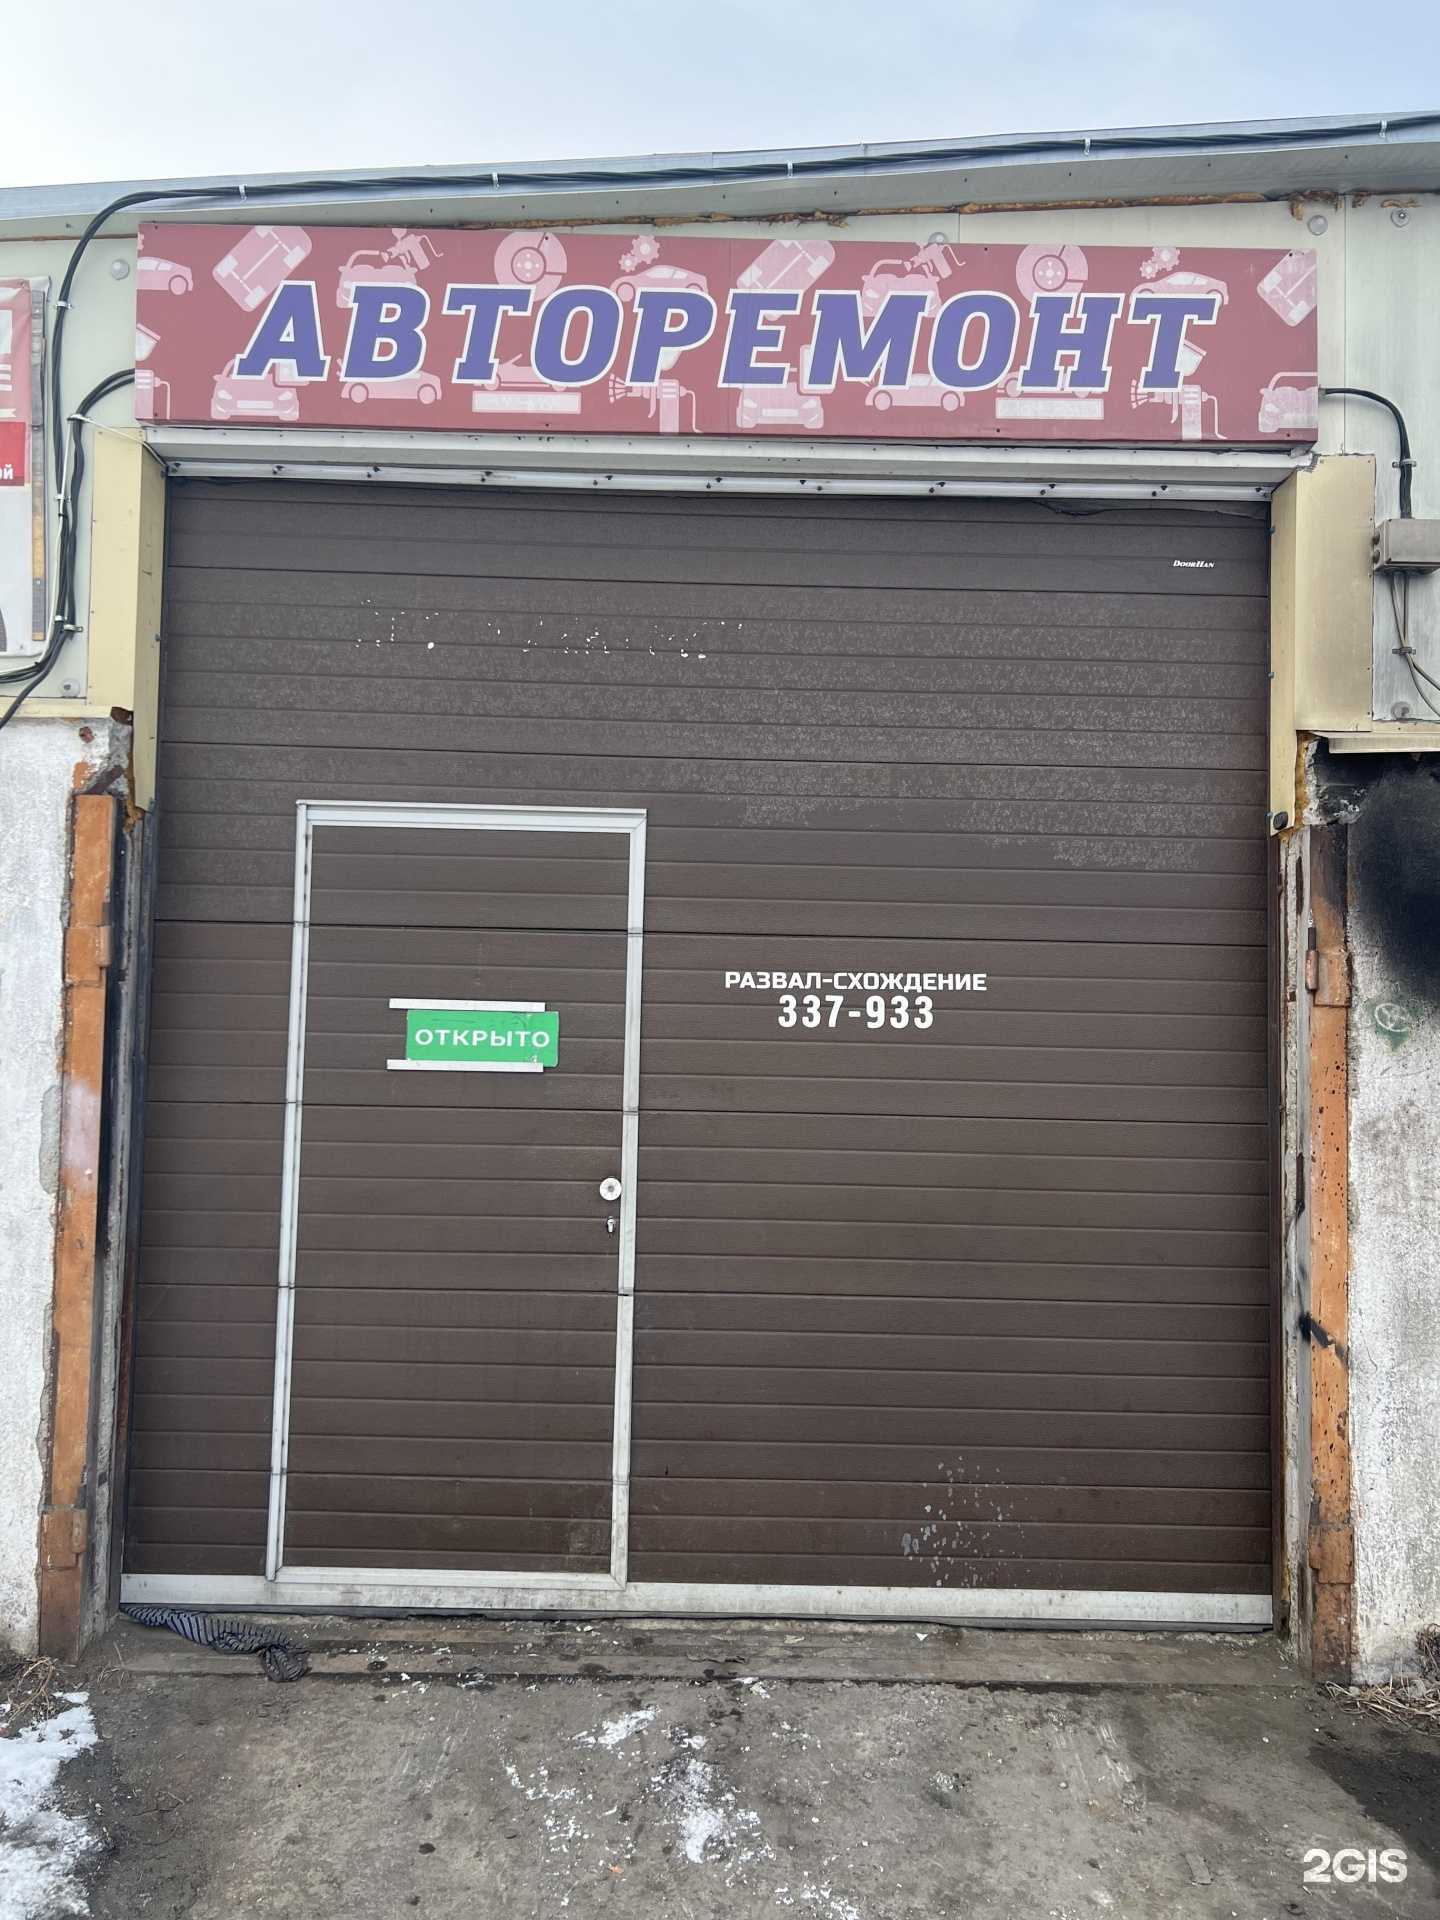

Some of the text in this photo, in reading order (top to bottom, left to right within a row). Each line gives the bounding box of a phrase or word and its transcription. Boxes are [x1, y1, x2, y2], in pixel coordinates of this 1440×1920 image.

[231, 279, 1220, 393] АВТОРЕМОНТ
[724, 971, 988, 993] РАЗВАЛ-СХОЖДЕНИЕ
[777, 994, 935, 1030] 337-933
[414, 1028, 551, 1048] ОТКРЫТО
